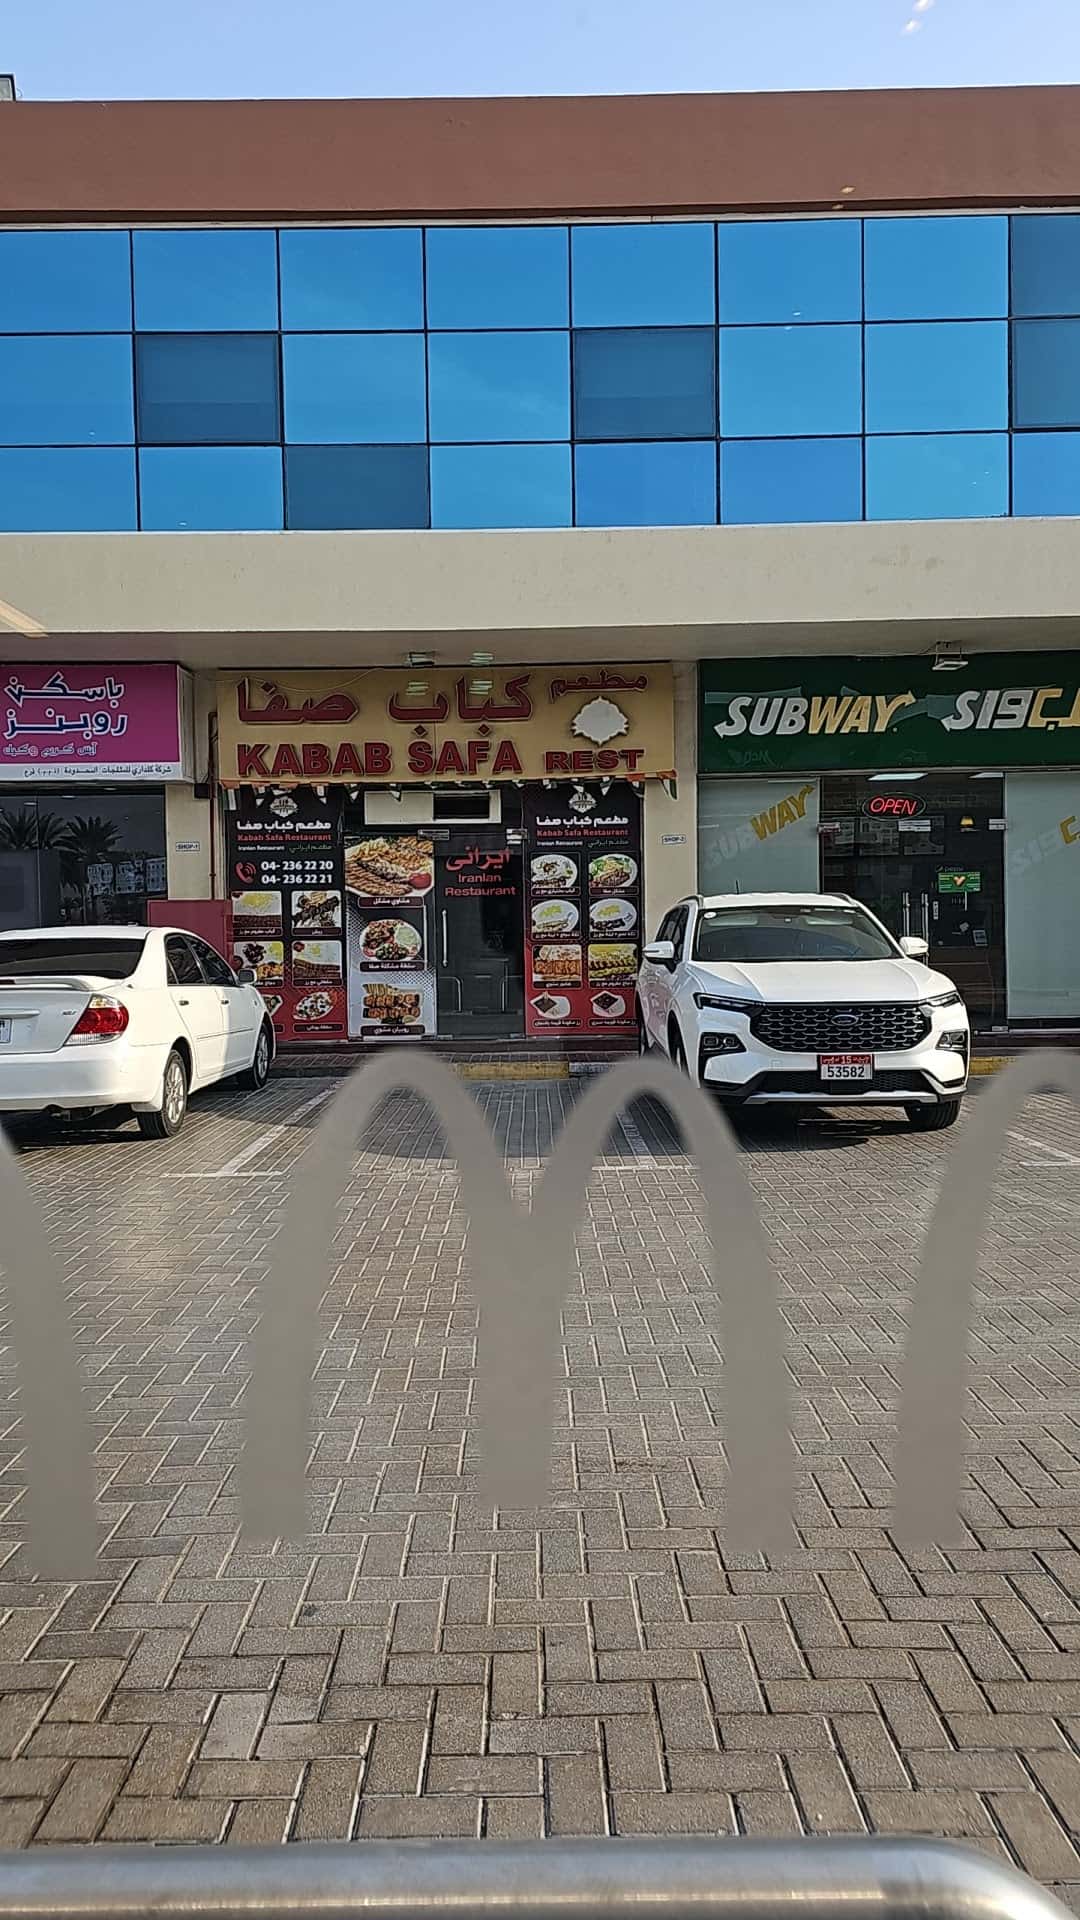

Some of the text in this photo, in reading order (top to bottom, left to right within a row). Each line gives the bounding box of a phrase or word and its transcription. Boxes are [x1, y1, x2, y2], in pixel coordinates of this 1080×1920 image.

[4, 671, 124, 708] باسكن
[237, 669, 648, 738] مطعم كباب صفا
[714, 690, 915, 738] SUBWAY
[3, 708, 128, 740] روبنز
[237, 740, 645, 777] KABAB SAFA REST
[870, 796, 917, 816] OPEN
[236, 819, 332, 833] مطعم كباب صفا
[536, 815, 629, 828] مطعم كباب صفا
[265, 833, 284, 841] Safa
[285, 833, 332, 841] Restaurant
[564, 829, 582, 837] Safa
[583, 829, 628, 837] Restaurant
[282, 861, 303, 871] 236
[305, 861, 317, 871] 22
[319, 861, 334, 871] 20
[282, 874, 303, 884] 236
[305, 874, 317, 884] 22
[319, 874, 333, 884] 21
[458, 873, 502, 883] Iranian
[445, 886, 516, 897] Restaurant
[827, 1065, 865, 1078] 53582
